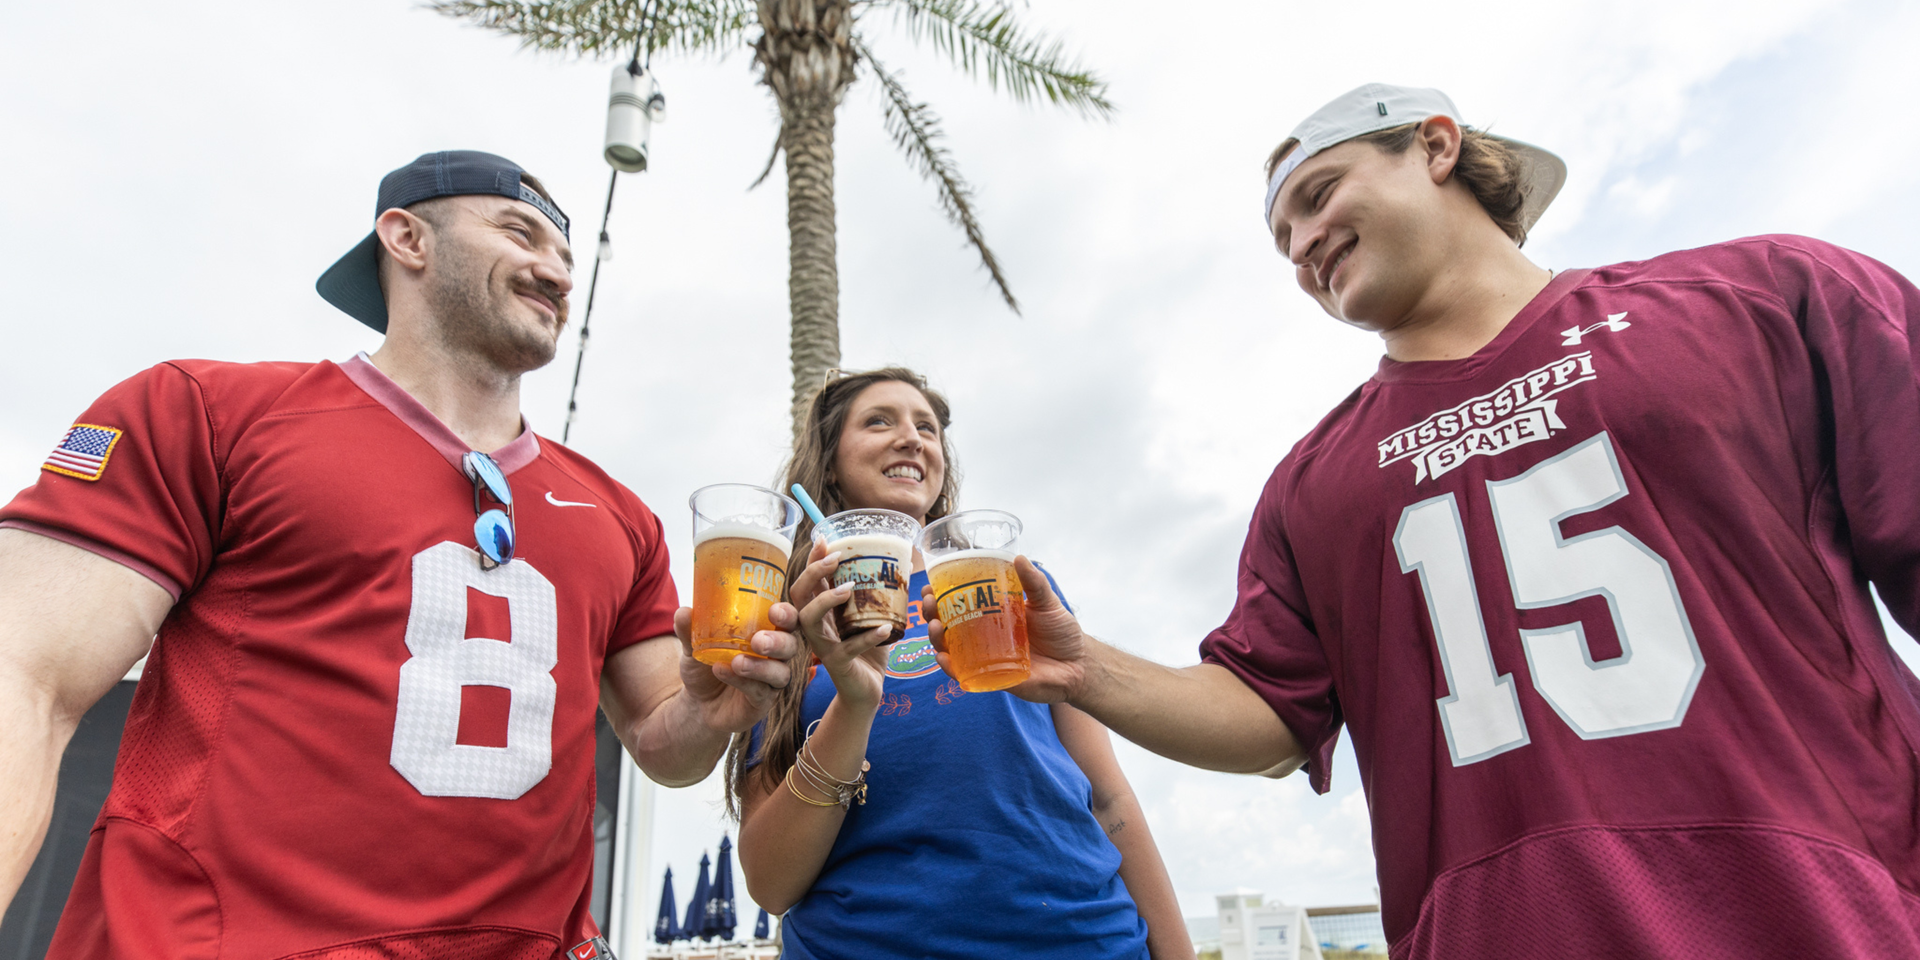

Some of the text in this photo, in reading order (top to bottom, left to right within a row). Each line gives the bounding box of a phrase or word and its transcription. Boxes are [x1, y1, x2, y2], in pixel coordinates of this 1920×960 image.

[1378, 355, 1596, 463] MISSISSIPPI
[1438, 418, 1535, 467] STATE
[937, 585, 1000, 625] OASTAL
[963, 610, 983, 622] BEACH
[1392, 430, 1706, 768] 15
[390, 540, 558, 800] 8
